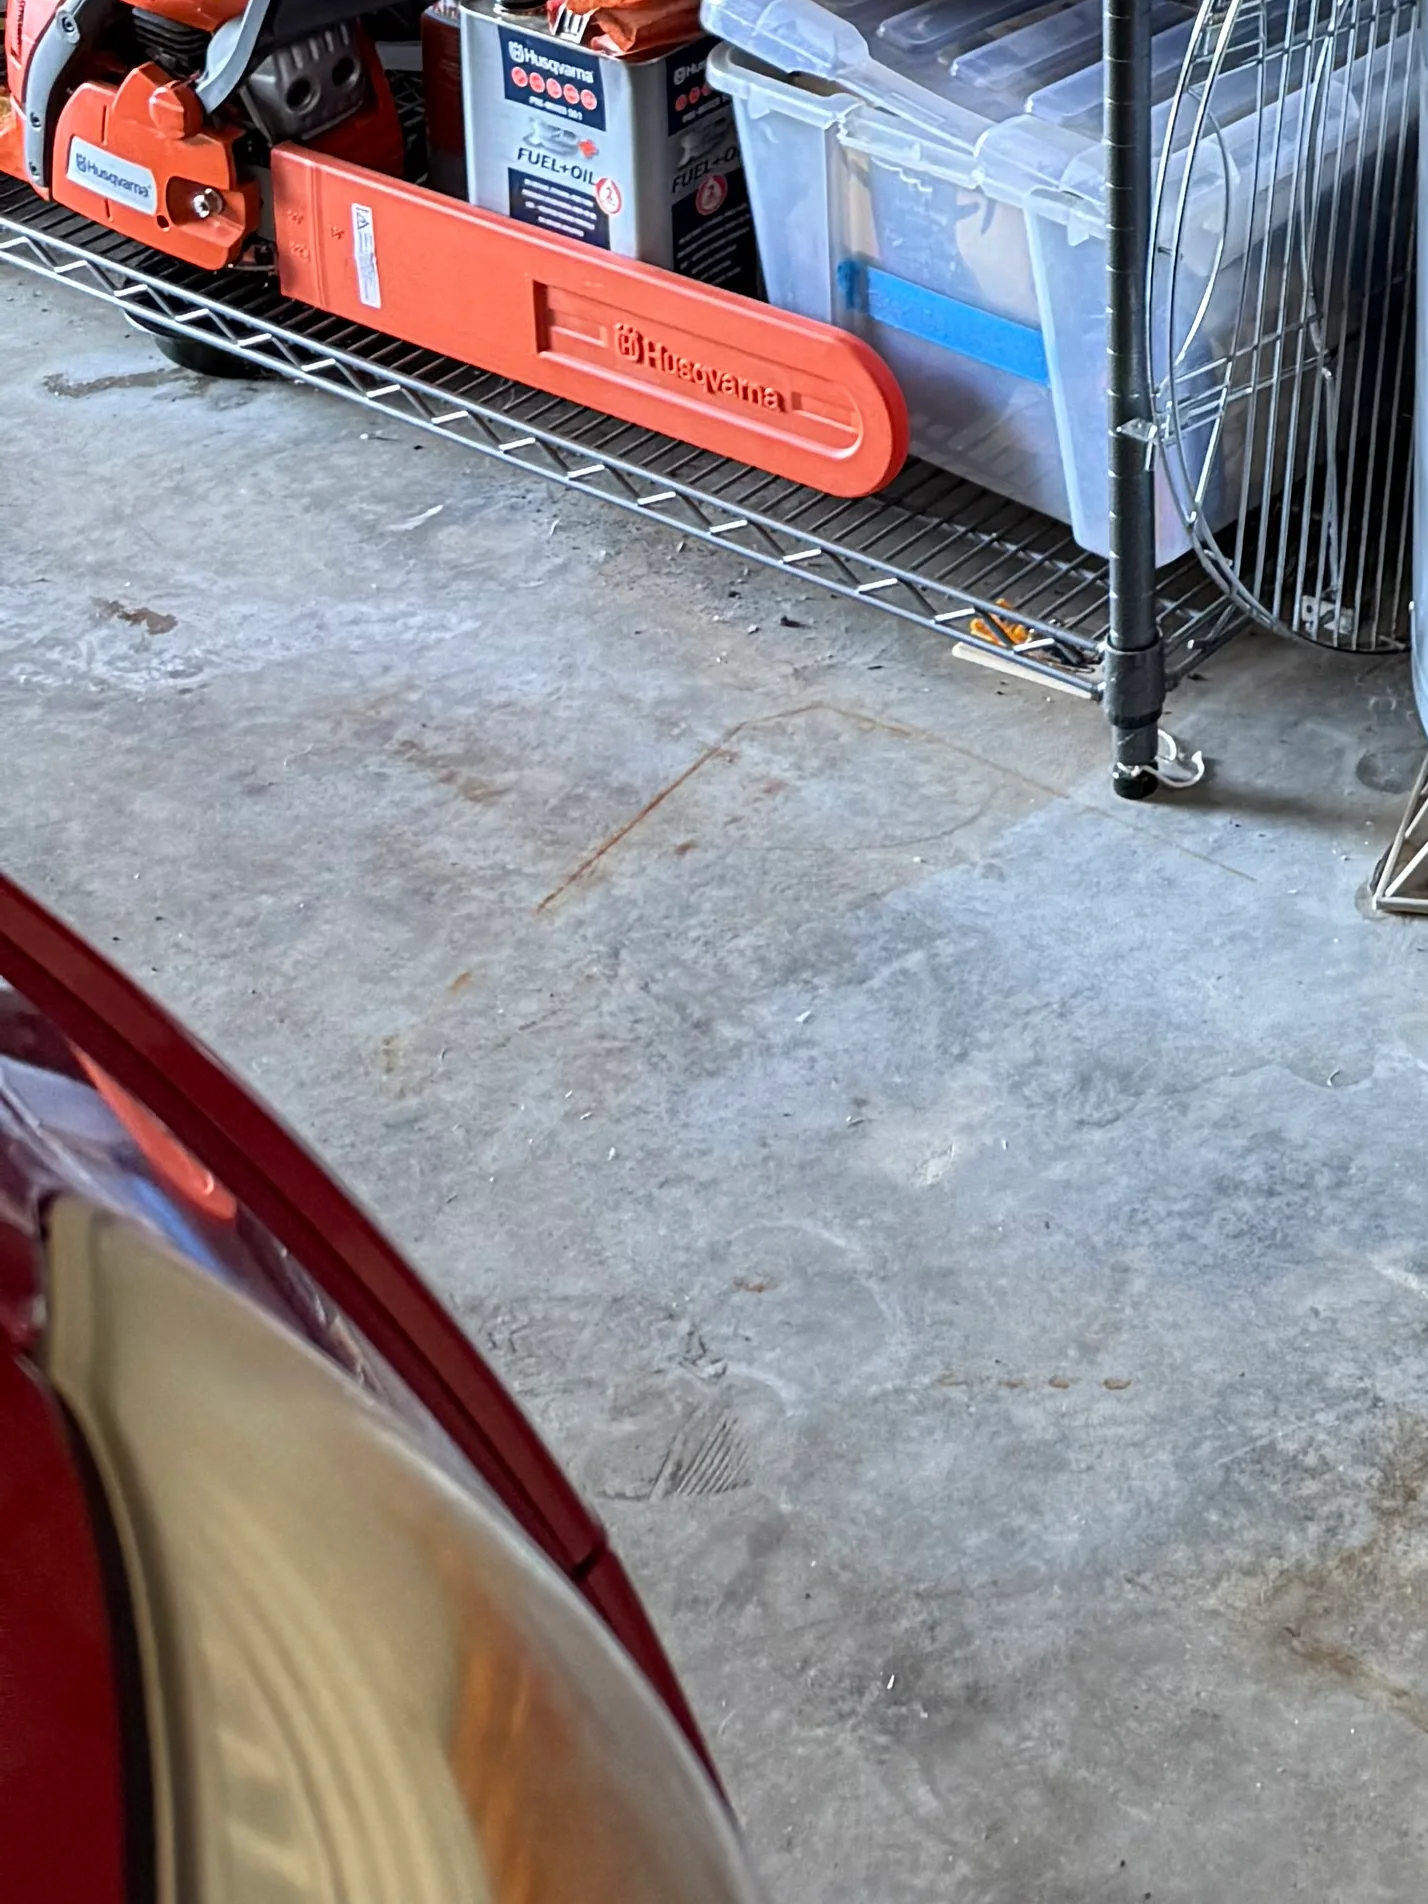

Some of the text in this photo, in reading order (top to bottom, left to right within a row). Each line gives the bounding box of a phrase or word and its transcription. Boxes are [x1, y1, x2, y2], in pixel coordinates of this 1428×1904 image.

[523, 46, 595, 84] Husqvarna
[86, 160, 149, 198] Husqvarna
[517, 147, 598, 186] FUEL+OIL
[644, 340, 787, 413] Husqvarna
